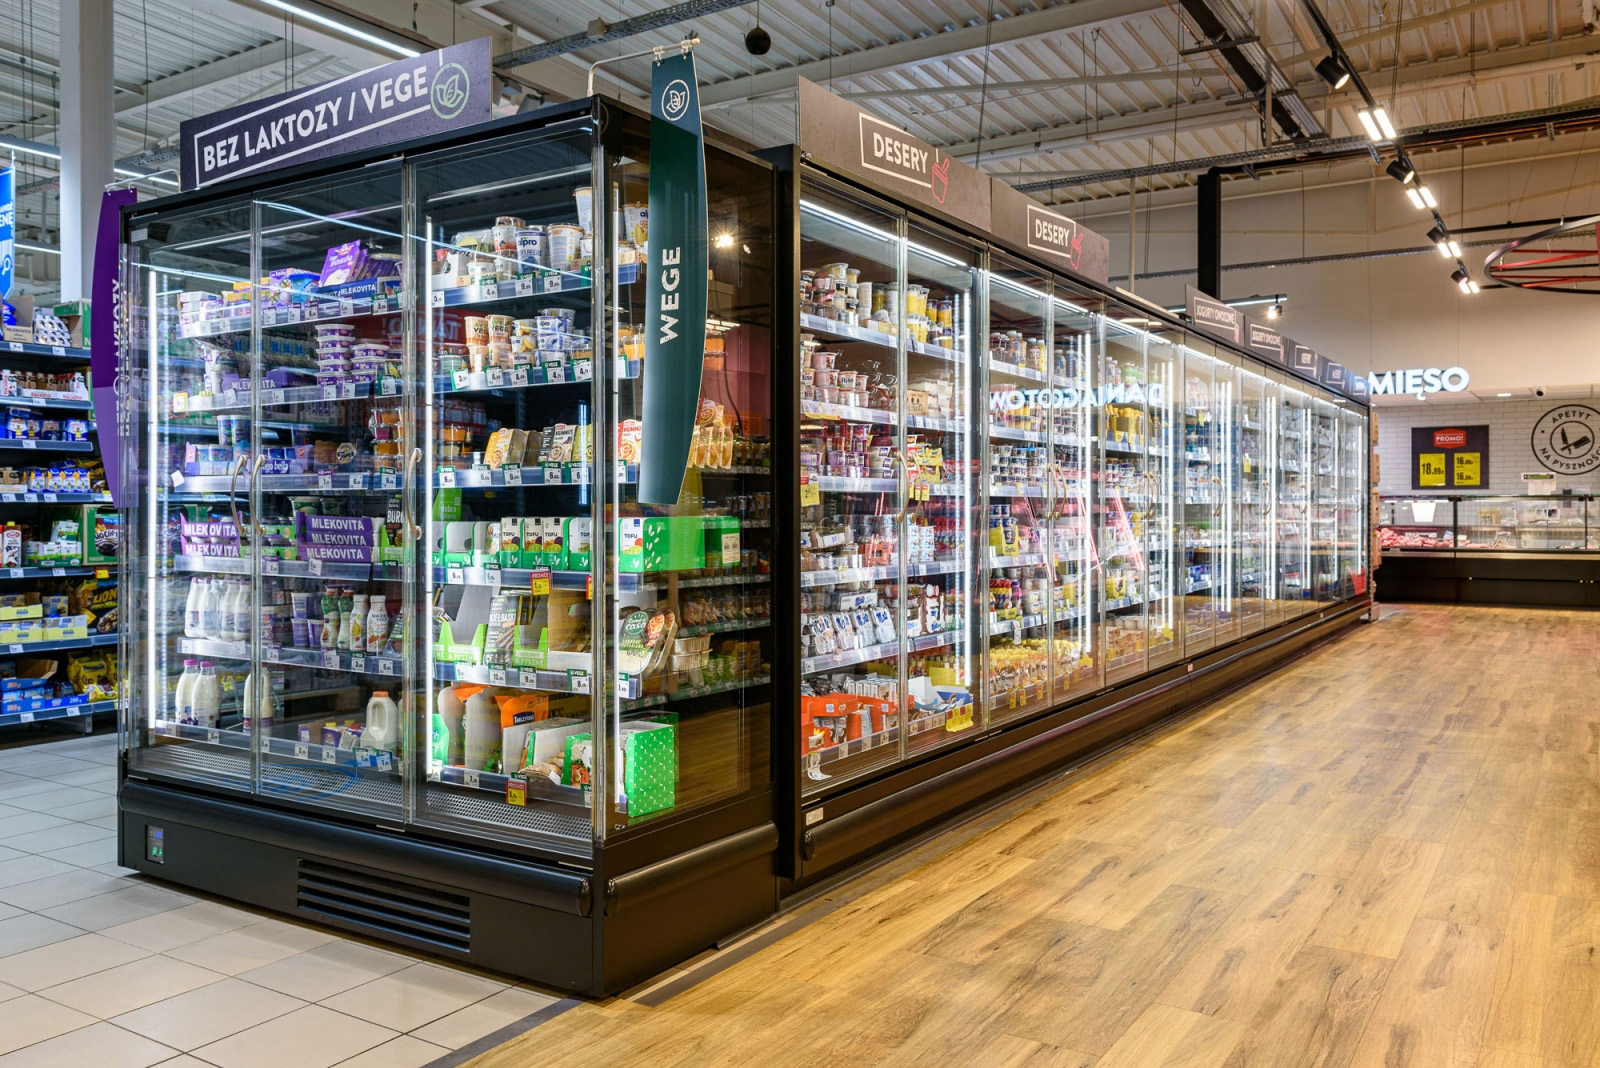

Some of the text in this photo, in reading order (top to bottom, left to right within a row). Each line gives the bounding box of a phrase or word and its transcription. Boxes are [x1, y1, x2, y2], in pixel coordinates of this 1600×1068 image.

[203, 65, 428, 172] BEZ LAKTOZY / VEGE
[873, 132, 928, 174] DESERY
[1035, 218, 1070, 248] DESERY
[340, 284, 376, 295] MLEKOVITA
[659, 246, 681, 345] WEGE
[1368, 366, 1470, 401] MIĘSO
[1552, 410, 1592, 424] APETYT
[1540, 447, 1552, 461] NA
[184, 523, 237, 537] MLEKOVITA
[311, 518, 365, 531] MLEKOVITA
[311, 533, 367, 546] MLEKOVITA
[185, 545, 239, 557] MLEKOVITA
[306, 548, 364, 560] MLEKOVITA
[93, 589, 117, 603] LION
